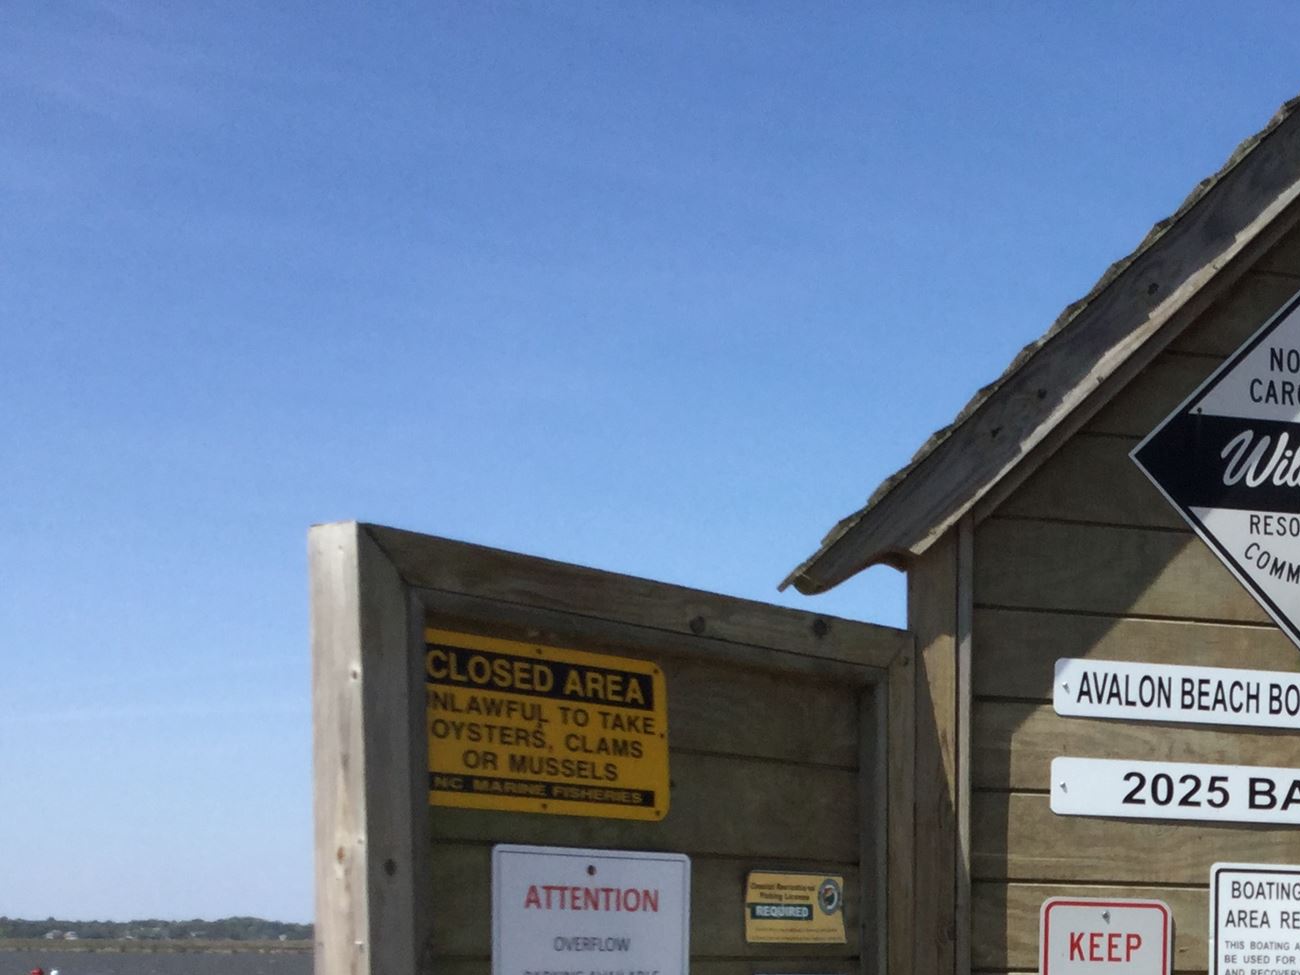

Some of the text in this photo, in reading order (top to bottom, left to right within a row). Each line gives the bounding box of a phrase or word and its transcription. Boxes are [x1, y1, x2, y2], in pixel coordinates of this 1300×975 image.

[426, 649, 645, 705] CLOSED AREA
[1077, 671, 1172, 709] AVALON
[1181, 679, 1260, 714] BEACH
[558, 706, 589, 727] TO
[599, 711, 655, 735] TAKE
[565, 734, 643, 759] CLAMS
[463, 751, 618, 781] OR MUSSELS
[472, 780, 548, 797] MARINE
[552, 786, 643, 804] FISHERIES
[1122, 772, 1230, 808] 2025
[524, 885, 659, 913] ATTENTION
[756, 906, 809, 917] REQUIRED
[1225, 910, 1271, 929] AREA
[553, 936, 631, 952] OVERFLOW
[1070, 932, 1142, 962] KEEP
[1225, 940, 1245, 950] THIS
[1250, 941, 1290, 951] BOATING
[1224, 955, 1236, 964] BE
[1243, 955, 1270, 965] USED
[1276, 955, 1295, 965] FOR
